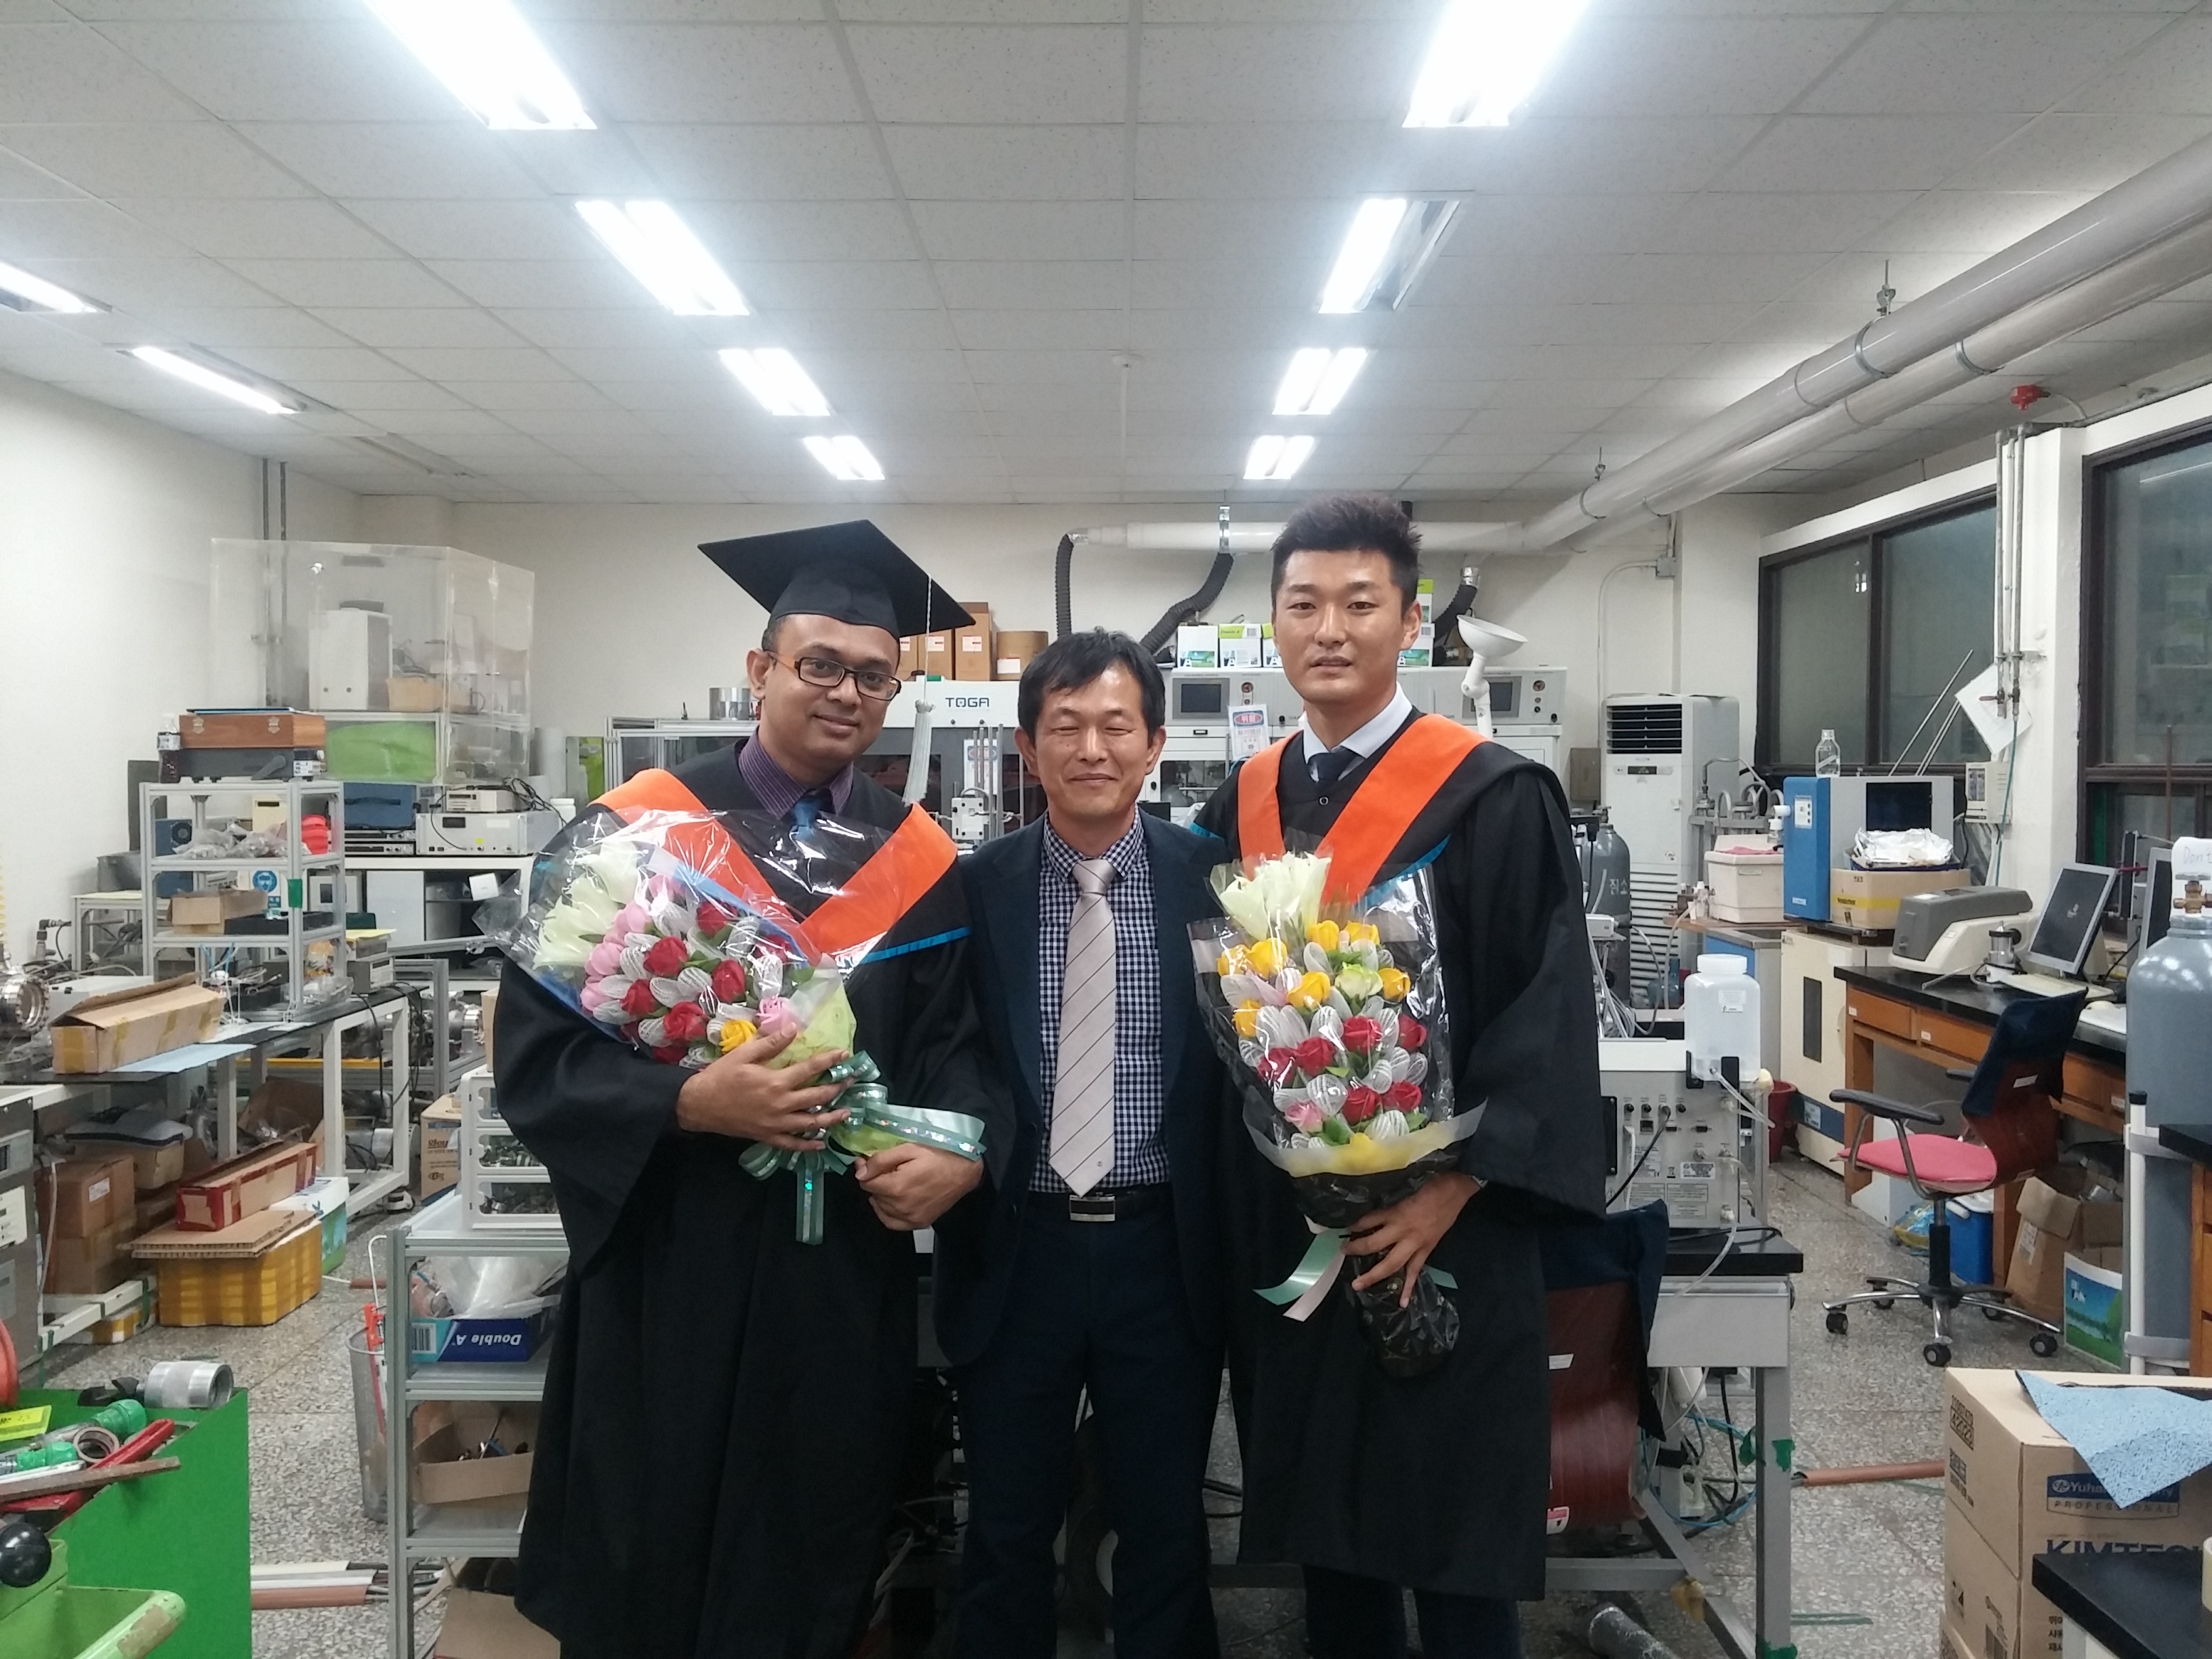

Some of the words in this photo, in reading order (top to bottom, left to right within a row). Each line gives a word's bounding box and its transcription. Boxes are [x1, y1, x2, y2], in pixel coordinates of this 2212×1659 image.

[945, 697, 990, 708] TOGA
[1609, 878, 1628, 895] 질소
[456, 1334, 468, 1346] A
[471, 1334, 522, 1346] Double
[2054, 1500, 2172, 1513] PROFESIONAL
[2046, 1539, 2201, 1554] KIMT
